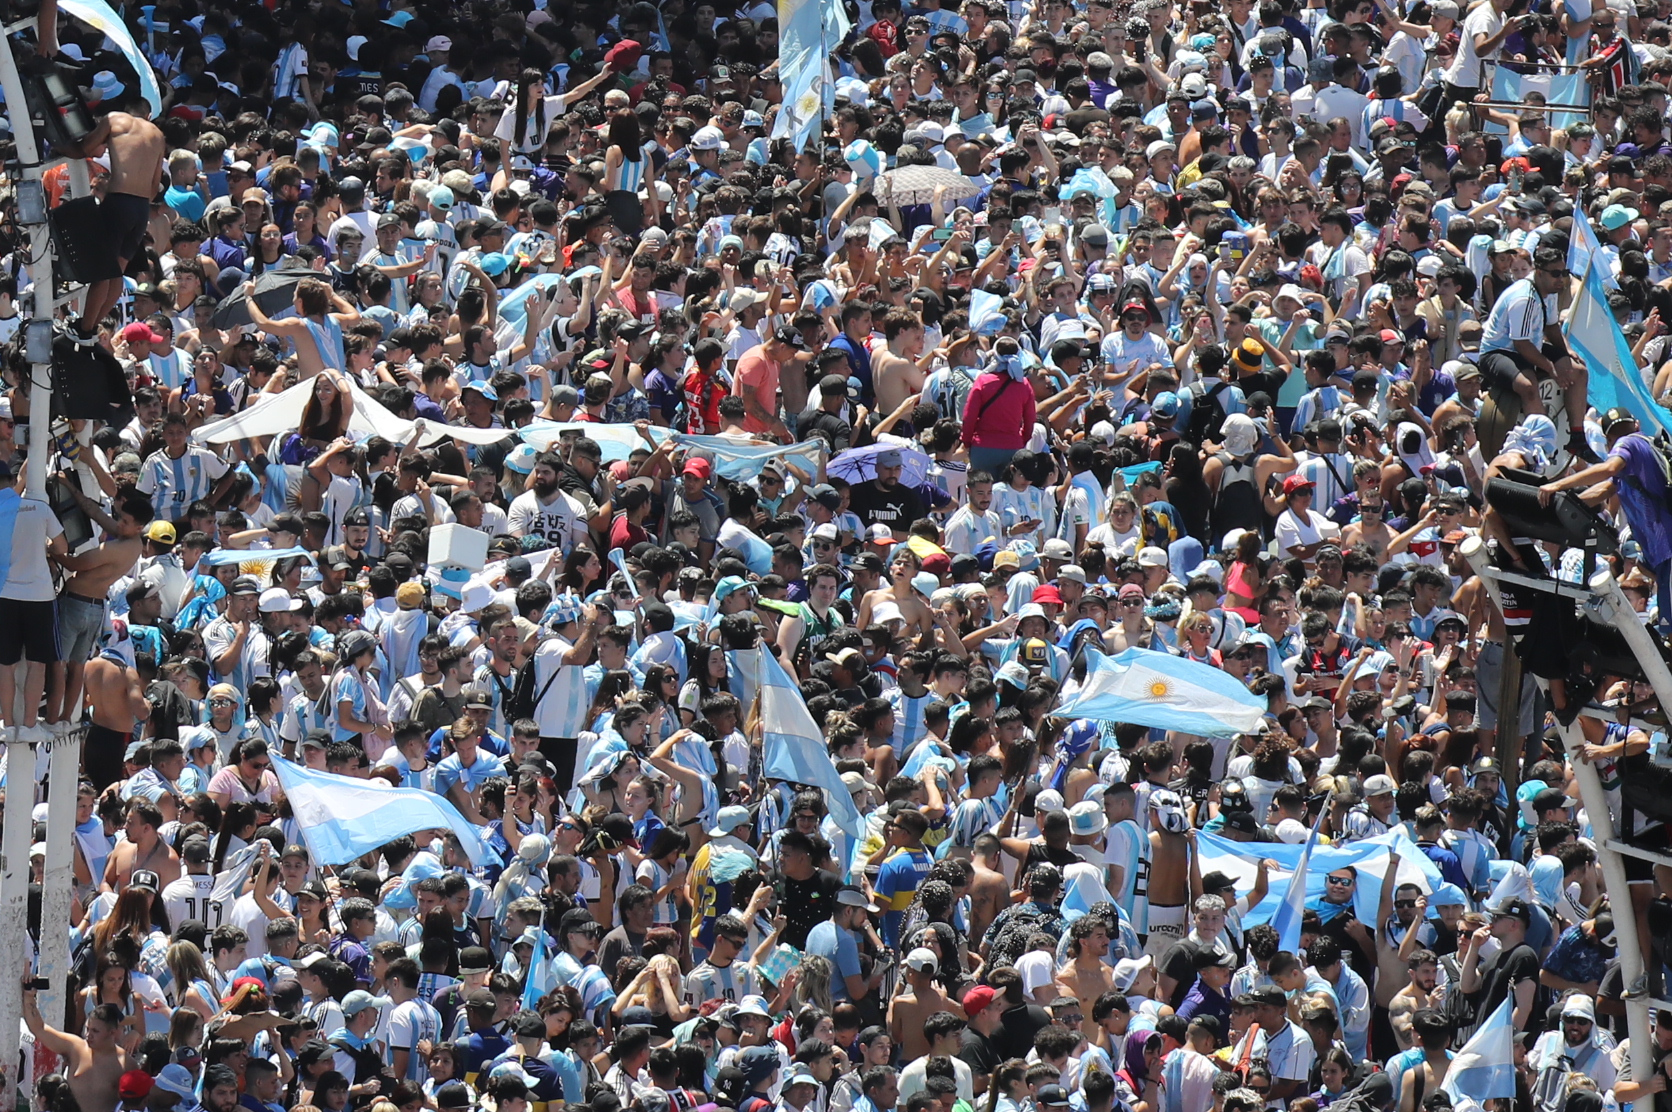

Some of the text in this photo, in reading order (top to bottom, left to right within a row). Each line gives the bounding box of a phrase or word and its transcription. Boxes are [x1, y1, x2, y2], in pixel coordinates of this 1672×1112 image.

[530, 135, 540, 146] 10
[776, 250, 796, 266] 10
[641, 313, 655, 323] NIKE
[1540, 383, 1552, 400] 12
[172, 489, 185, 502] 10
[868, 509, 897, 521] PUMA
[698, 885, 716, 917] 12
[722, 989, 735, 1001] 10
[724, 1079, 732, 1090] NY
